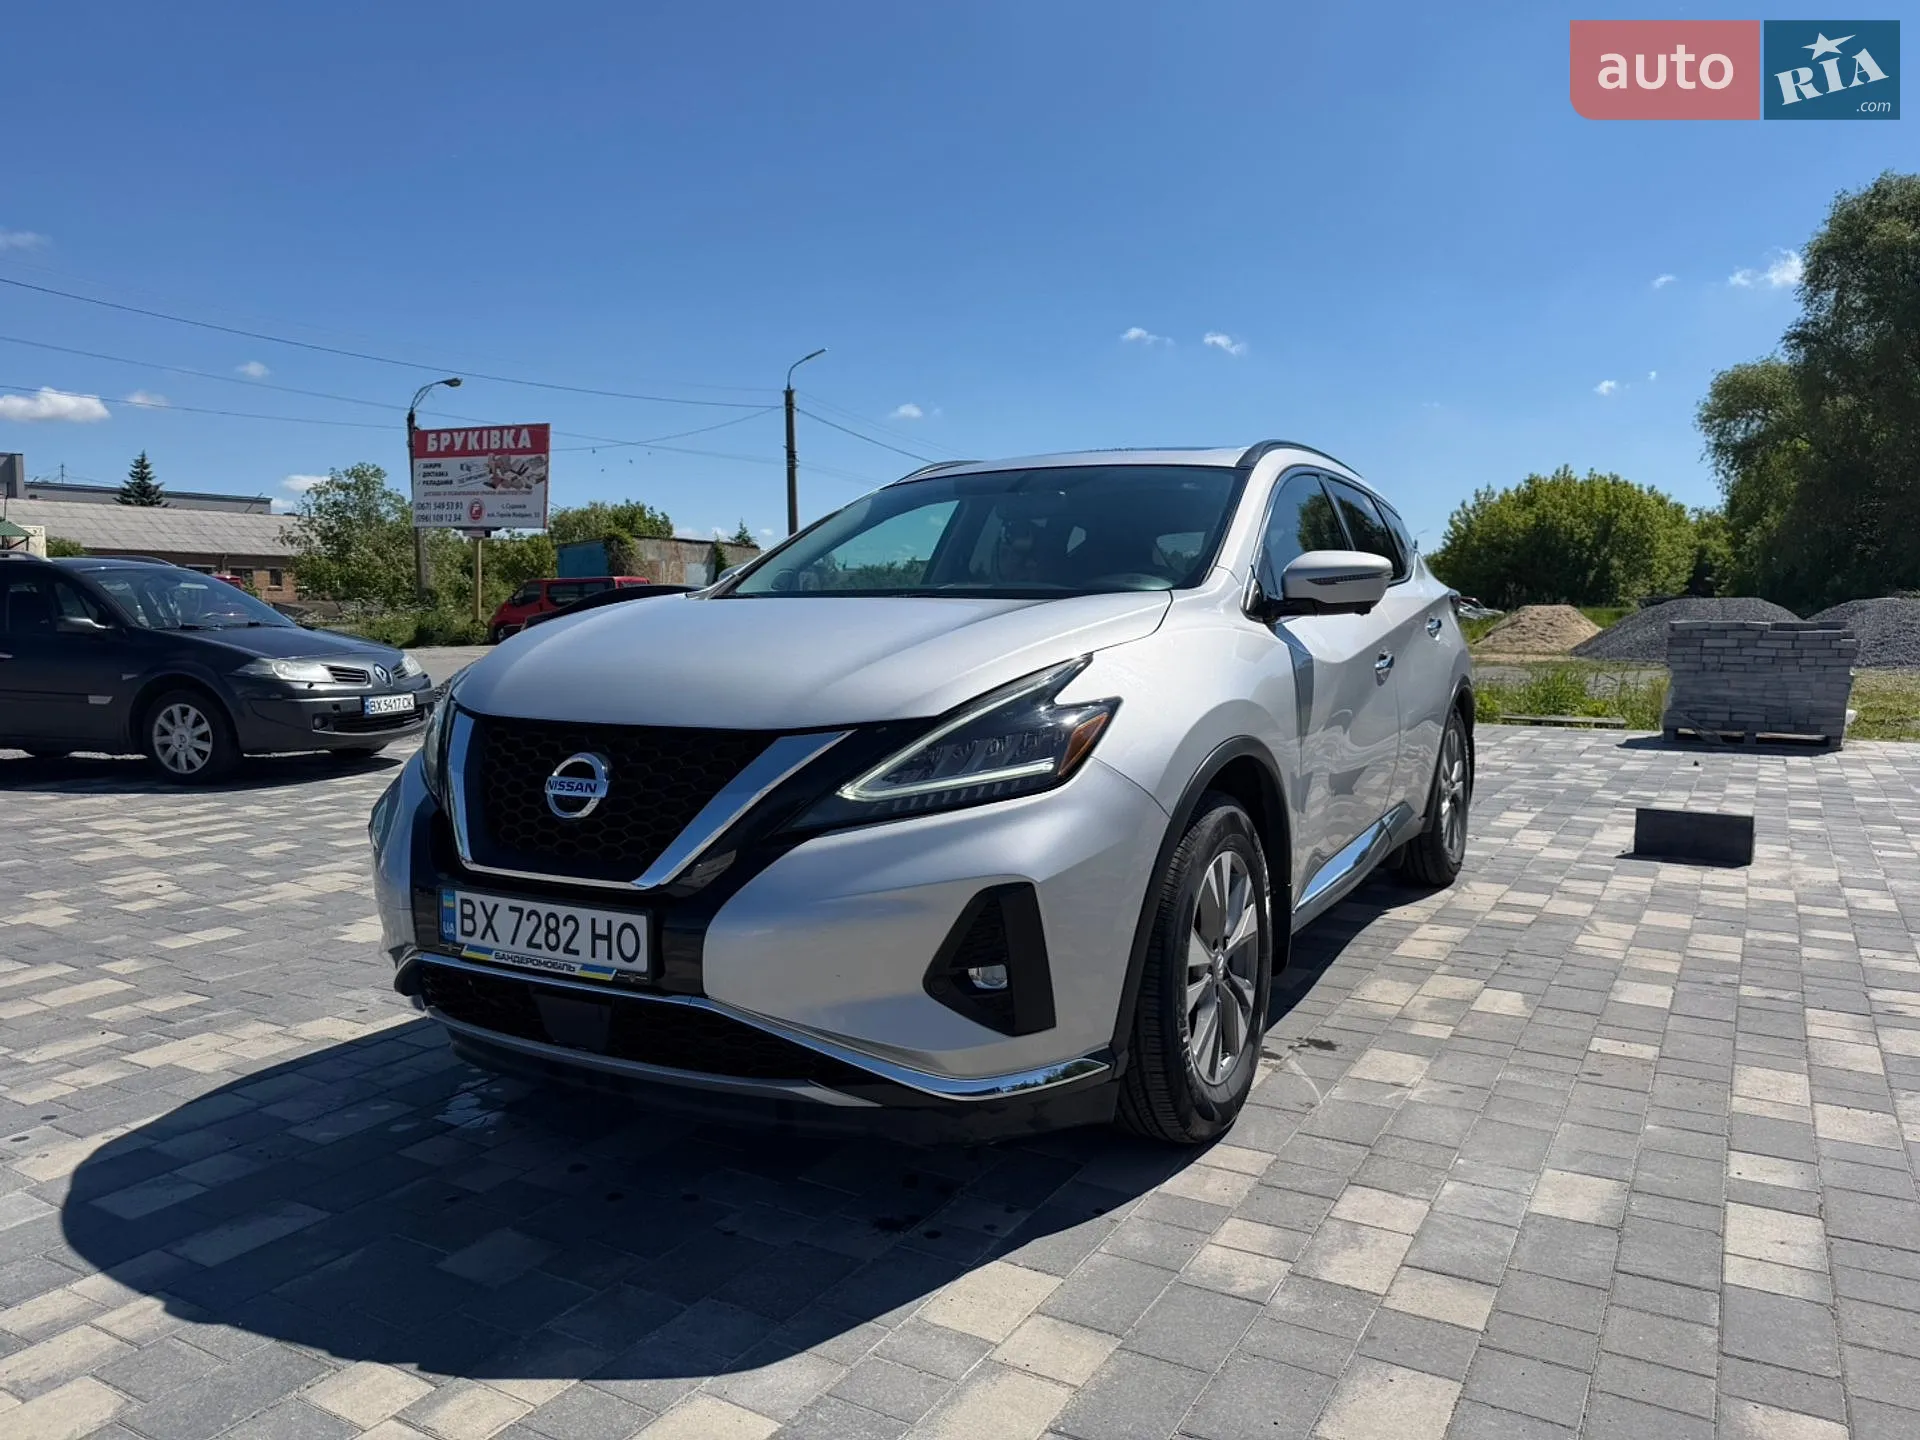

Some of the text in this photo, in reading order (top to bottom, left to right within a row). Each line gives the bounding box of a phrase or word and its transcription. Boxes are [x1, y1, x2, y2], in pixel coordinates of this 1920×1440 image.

[427, 428, 532, 452] БРУКІВКА
[370, 700, 383, 713] BX
[383, 697, 402, 712] 5417
[402, 697, 414, 709] CK
[549, 779, 598, 793] NISSAN
[443, 921, 455, 936] UA
[460, 898, 641, 964] BX 7282 HO
[494, 951, 576, 972] БАНДЕРОМОБІЛЬ
